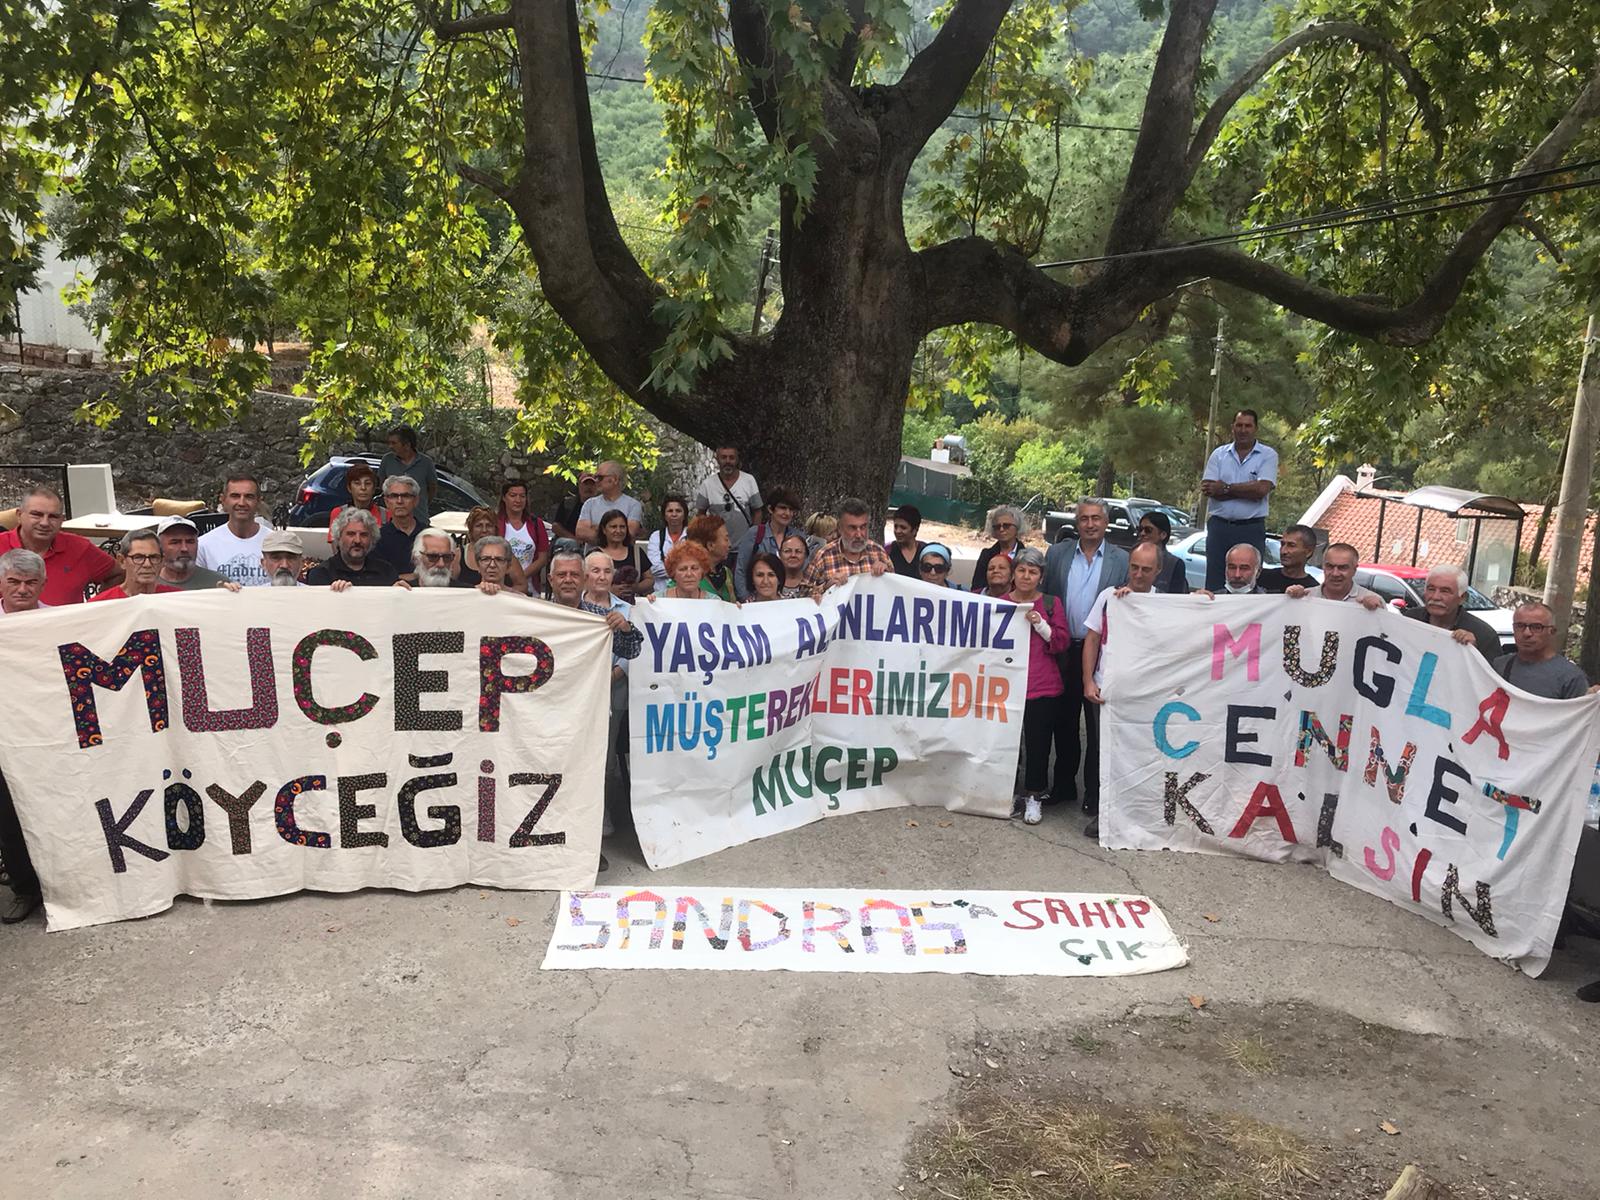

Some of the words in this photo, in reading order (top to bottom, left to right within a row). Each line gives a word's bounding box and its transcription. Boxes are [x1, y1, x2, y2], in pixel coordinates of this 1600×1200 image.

[58, 627, 554, 749] MUÇEP
[645, 622, 772, 685] YAŞAM
[795, 594, 1016, 660] ALNLARIMIZ
[645, 658, 1010, 760] MÜŞTEREKLERİMİZDİR
[95, 752, 566, 874] KÖYCEĞİZ
[752, 746, 899, 816] MUÇEP
[1153, 702, 1541, 860] CENNET
[1164, 771, 1498, 938] KALSIN
